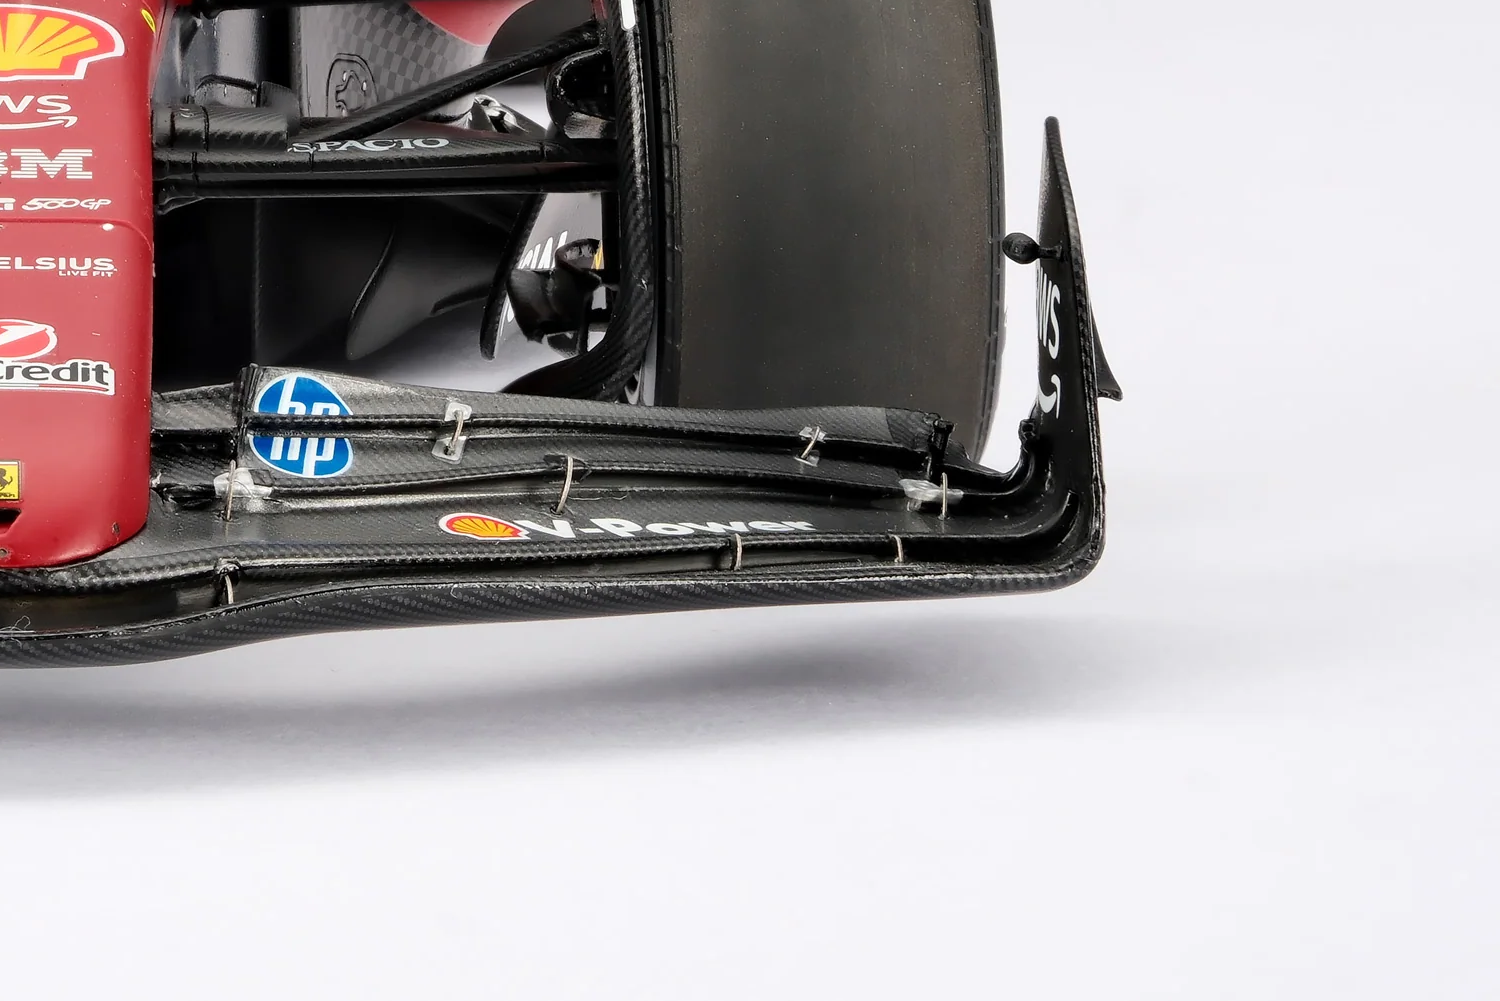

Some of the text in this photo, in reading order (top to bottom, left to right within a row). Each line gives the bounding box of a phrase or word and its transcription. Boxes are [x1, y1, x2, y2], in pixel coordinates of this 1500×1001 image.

[287, 138, 450, 152] SPACIO
[92, 270, 114, 278] FIT
[269, 376, 341, 477] hp
[513, 518, 817, 539] V-Power
